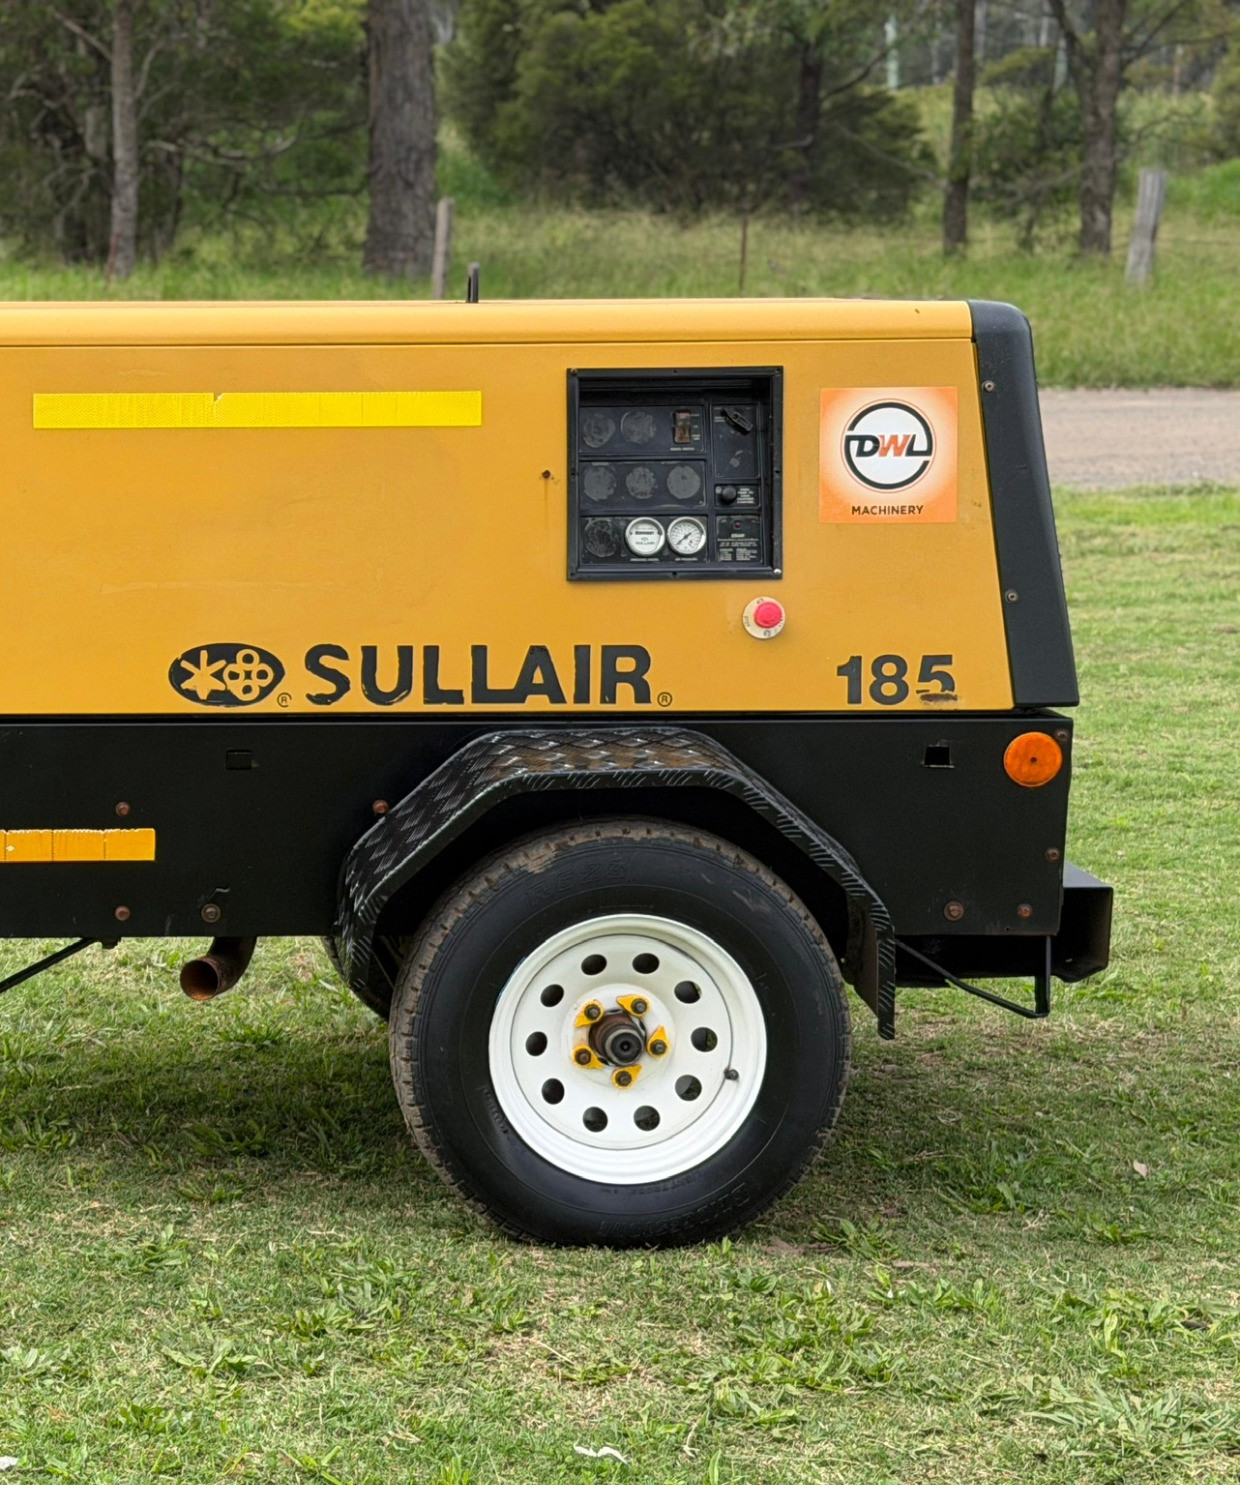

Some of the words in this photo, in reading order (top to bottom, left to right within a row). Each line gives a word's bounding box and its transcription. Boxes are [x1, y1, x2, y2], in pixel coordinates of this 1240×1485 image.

[845, 434, 934, 458] DWL
[851, 504, 925, 516] MACHINERY
[304, 643, 652, 706] SULLAIR
[836, 653, 958, 705] 185
